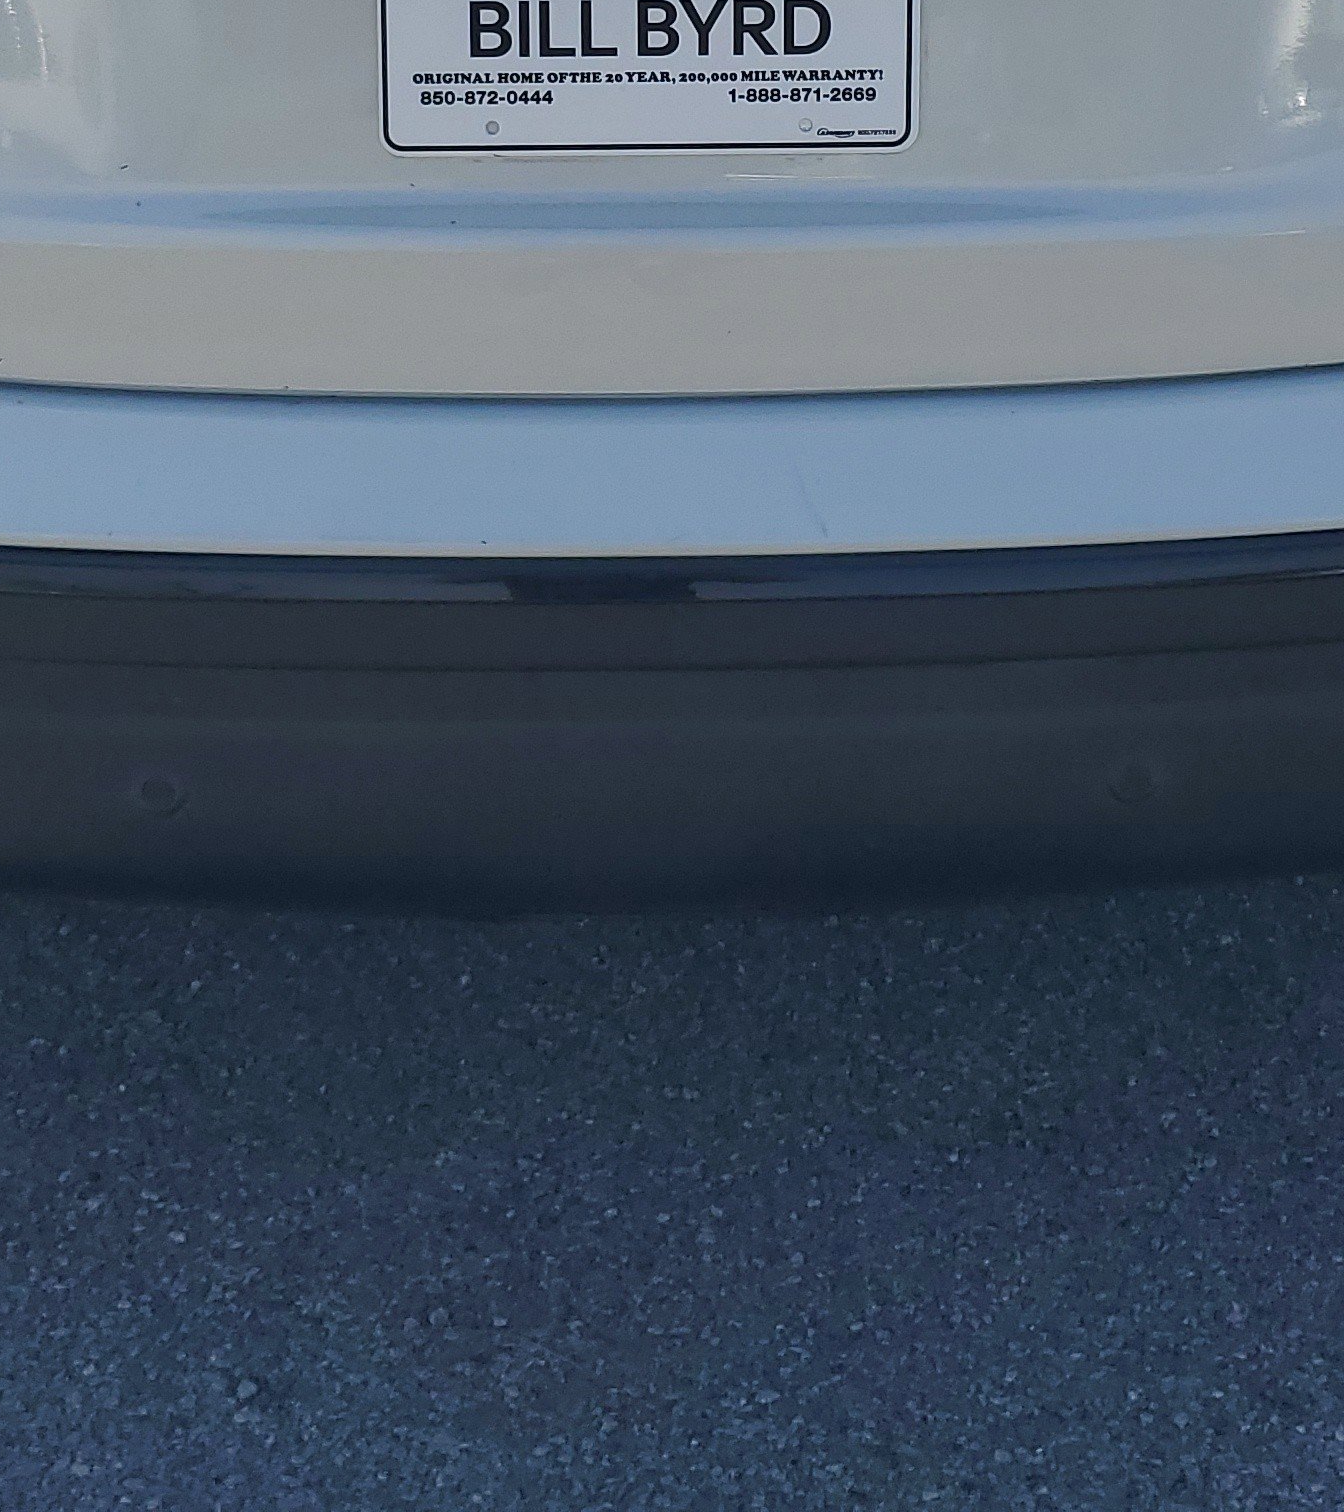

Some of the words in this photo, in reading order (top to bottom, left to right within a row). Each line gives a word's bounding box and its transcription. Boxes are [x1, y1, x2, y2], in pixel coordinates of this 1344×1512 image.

[469, 0, 618, 58] BILL
[412, 72, 494, 85] ORIGINAL
[497, 72, 544, 84] HOME
[605, 73, 623, 83] 20
[625, 71, 676, 84] YEAR,
[678, 72, 738, 85] 200,000
[741, 70, 781, 82] MILE
[782, 69, 884, 81] WARRANTY!
[420, 90, 554, 105] 850-872-0444
[728, 87, 877, 103] 1-888-871-2669
